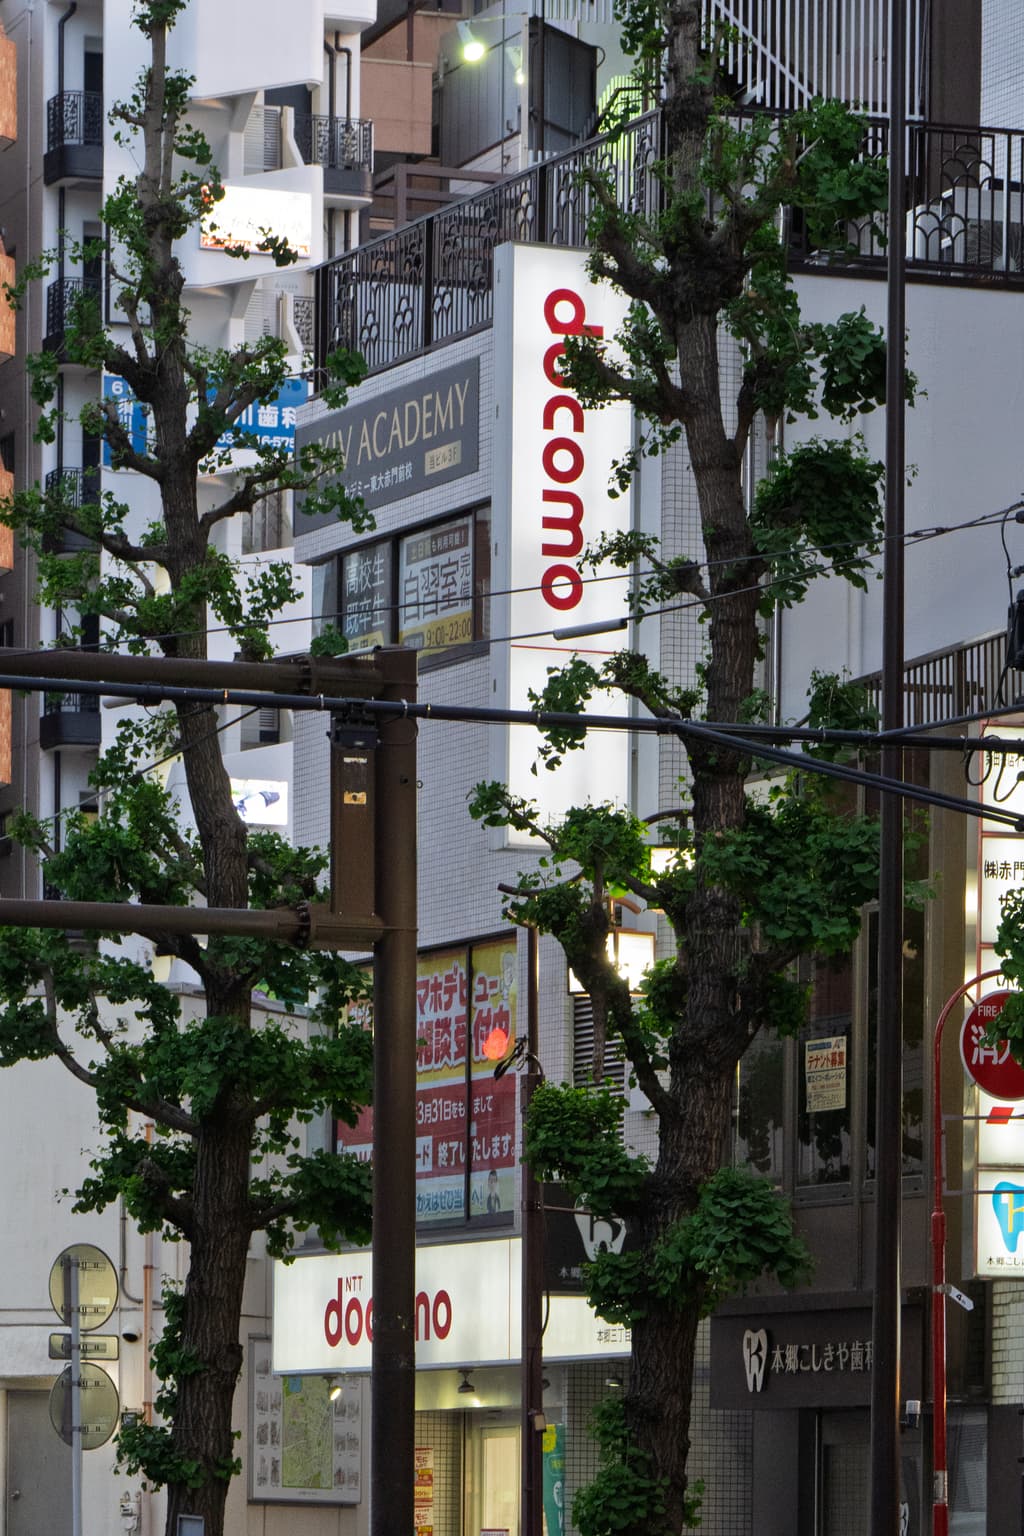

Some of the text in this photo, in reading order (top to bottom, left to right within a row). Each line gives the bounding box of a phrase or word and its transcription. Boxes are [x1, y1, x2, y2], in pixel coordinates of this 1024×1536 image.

[357, 378, 470, 465] ACADEMY
[541, 288, 604, 611] docomo
[346, 553, 385, 597] 高校生
[404, 557, 460, 624] 自習室
[346, 592, 385, 634] 既卒生
[426, 617, 472, 647] 9:00-22:00
[977, 1005, 997, 1017] FIRE
[808, 1051, 845, 1069] テナント募集
[345, 1276, 363, 1293] NTT
[324, 1277, 452, 1348] domo
